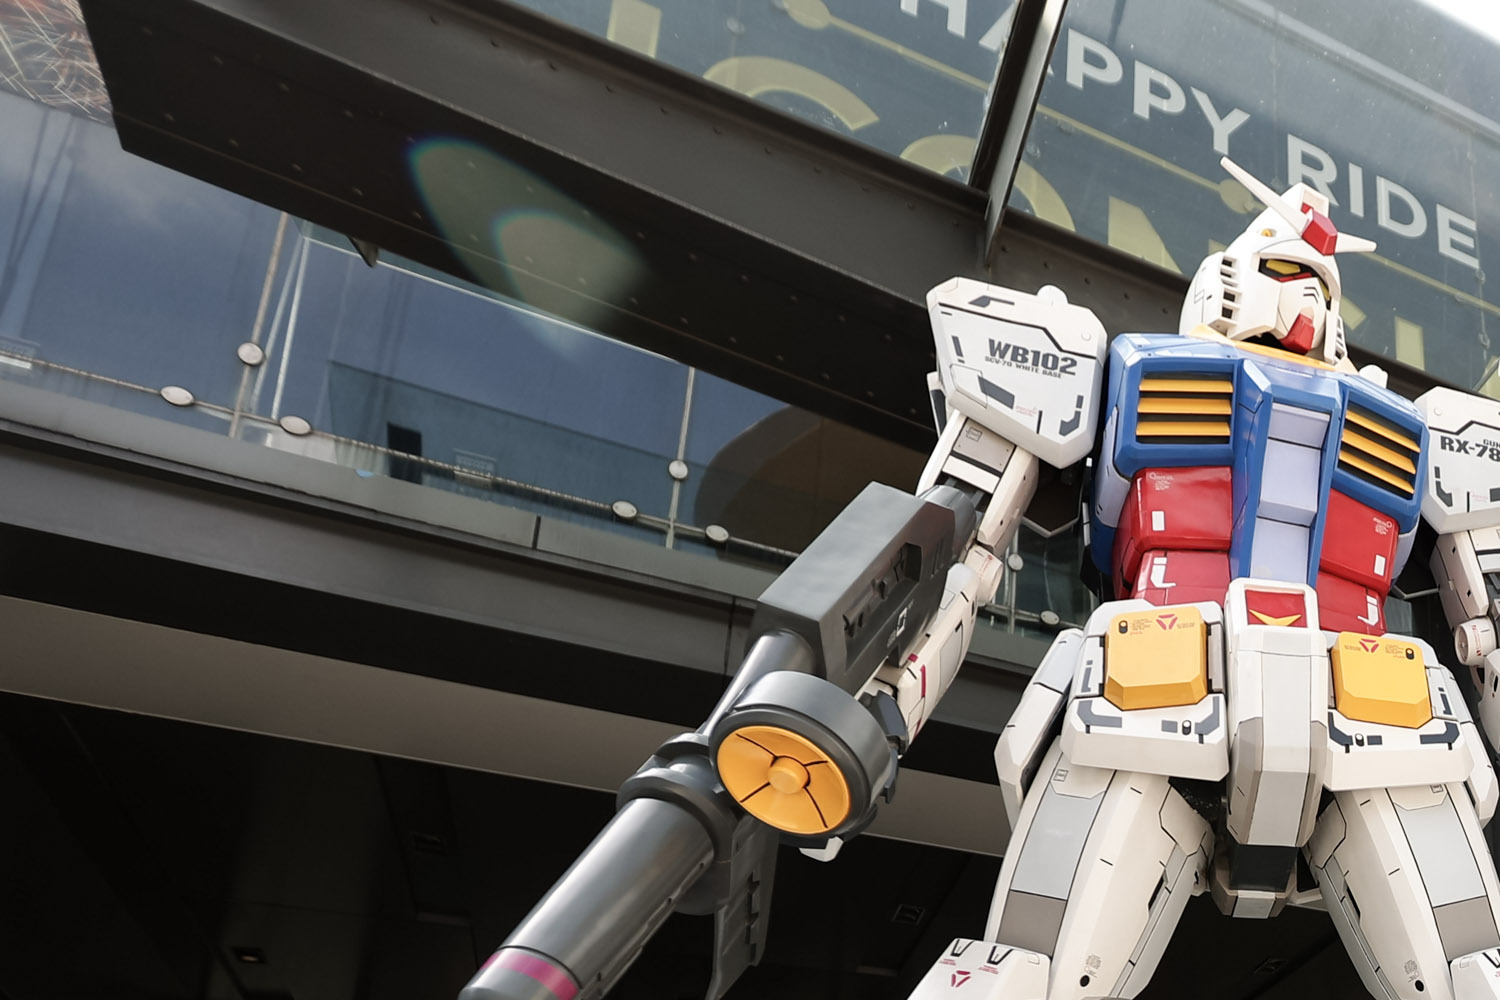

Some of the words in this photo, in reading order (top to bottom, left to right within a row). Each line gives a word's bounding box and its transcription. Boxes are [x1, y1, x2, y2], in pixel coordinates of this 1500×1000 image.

[1287, 134, 1481, 269] RIDE
[988, 338, 1078, 376] WB102
[1015, 363, 1040, 374] WHITE
[1042, 368, 1062, 379] BASE
